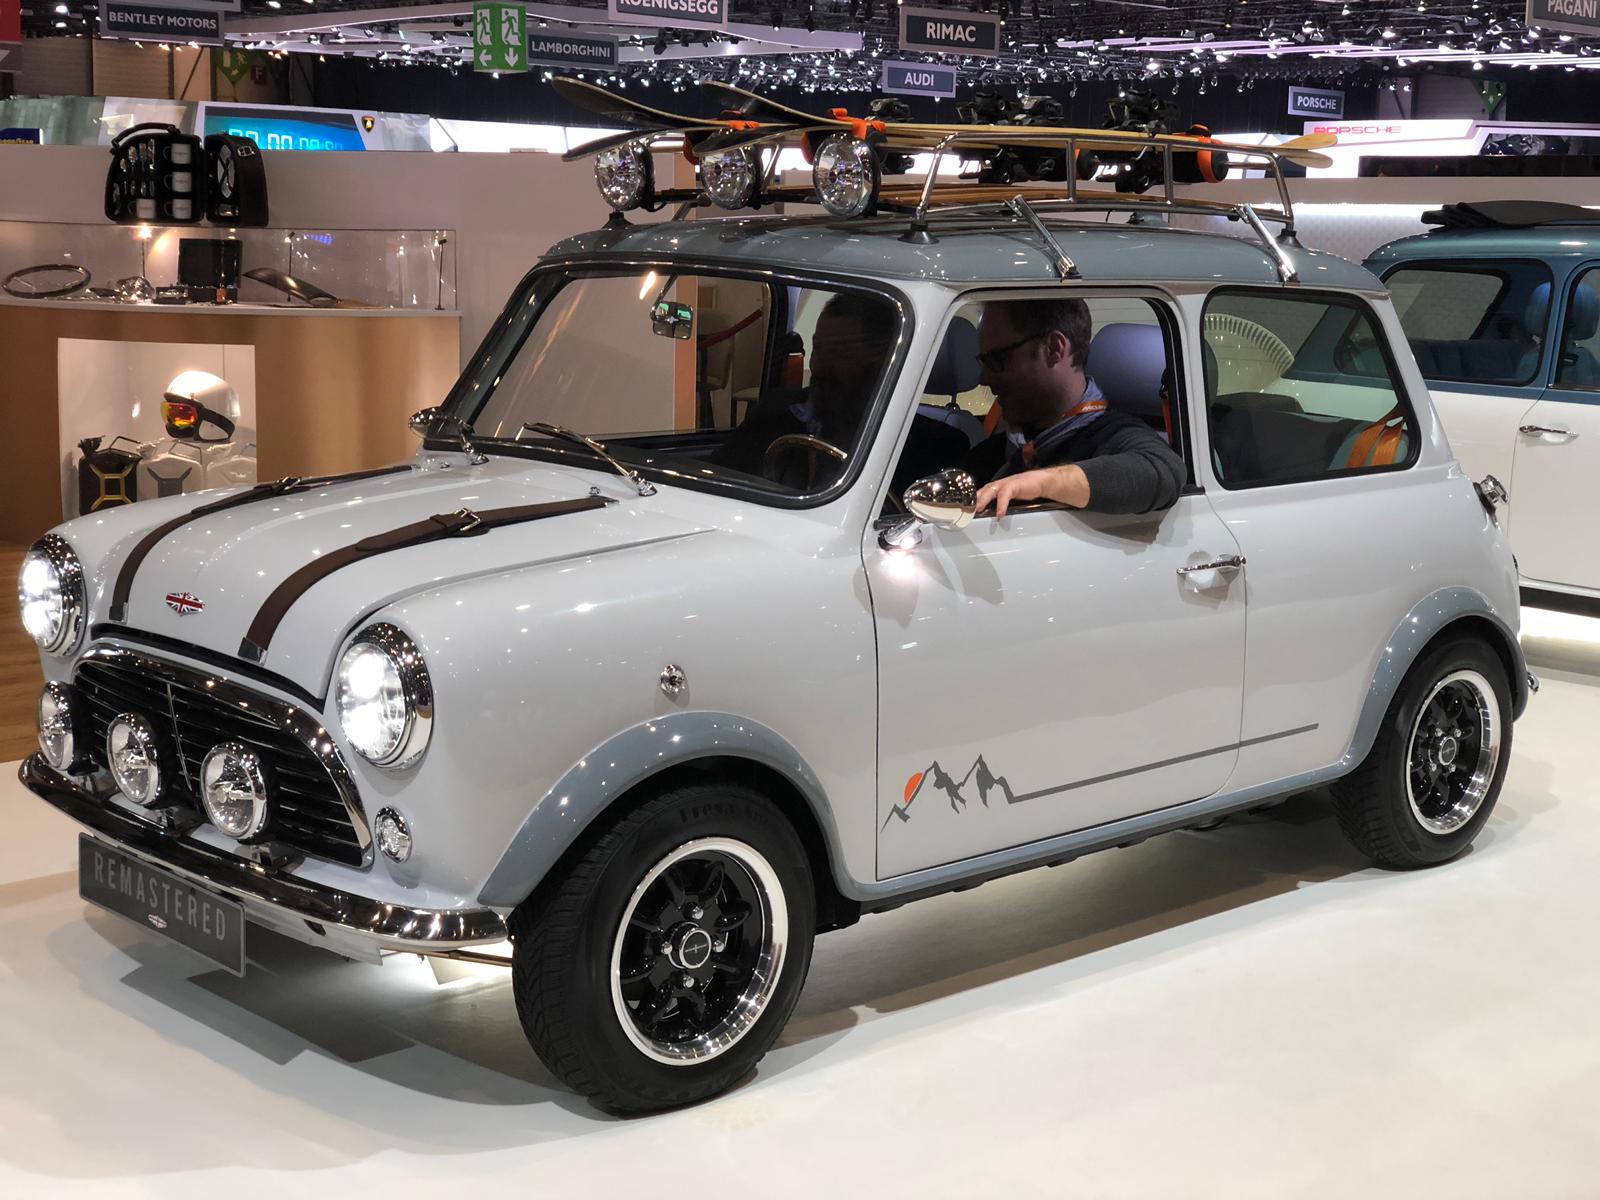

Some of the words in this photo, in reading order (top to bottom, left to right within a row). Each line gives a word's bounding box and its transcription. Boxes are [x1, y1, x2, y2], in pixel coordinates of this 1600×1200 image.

[1547, 0, 1598, 19] PAGANI
[108, 11, 165, 26] BENTLEY
[167, 15, 217, 30] MOTORS
[926, 21, 977, 43] RIMAC
[531, 41, 611, 59] LAMBORGHINI
[904, 71, 935, 87] AUDI
[1297, 95, 1337, 111] PORSCHE
[1313, 125, 1402, 135] PORSCHE
[94, 851, 226, 942] REMASTERED
